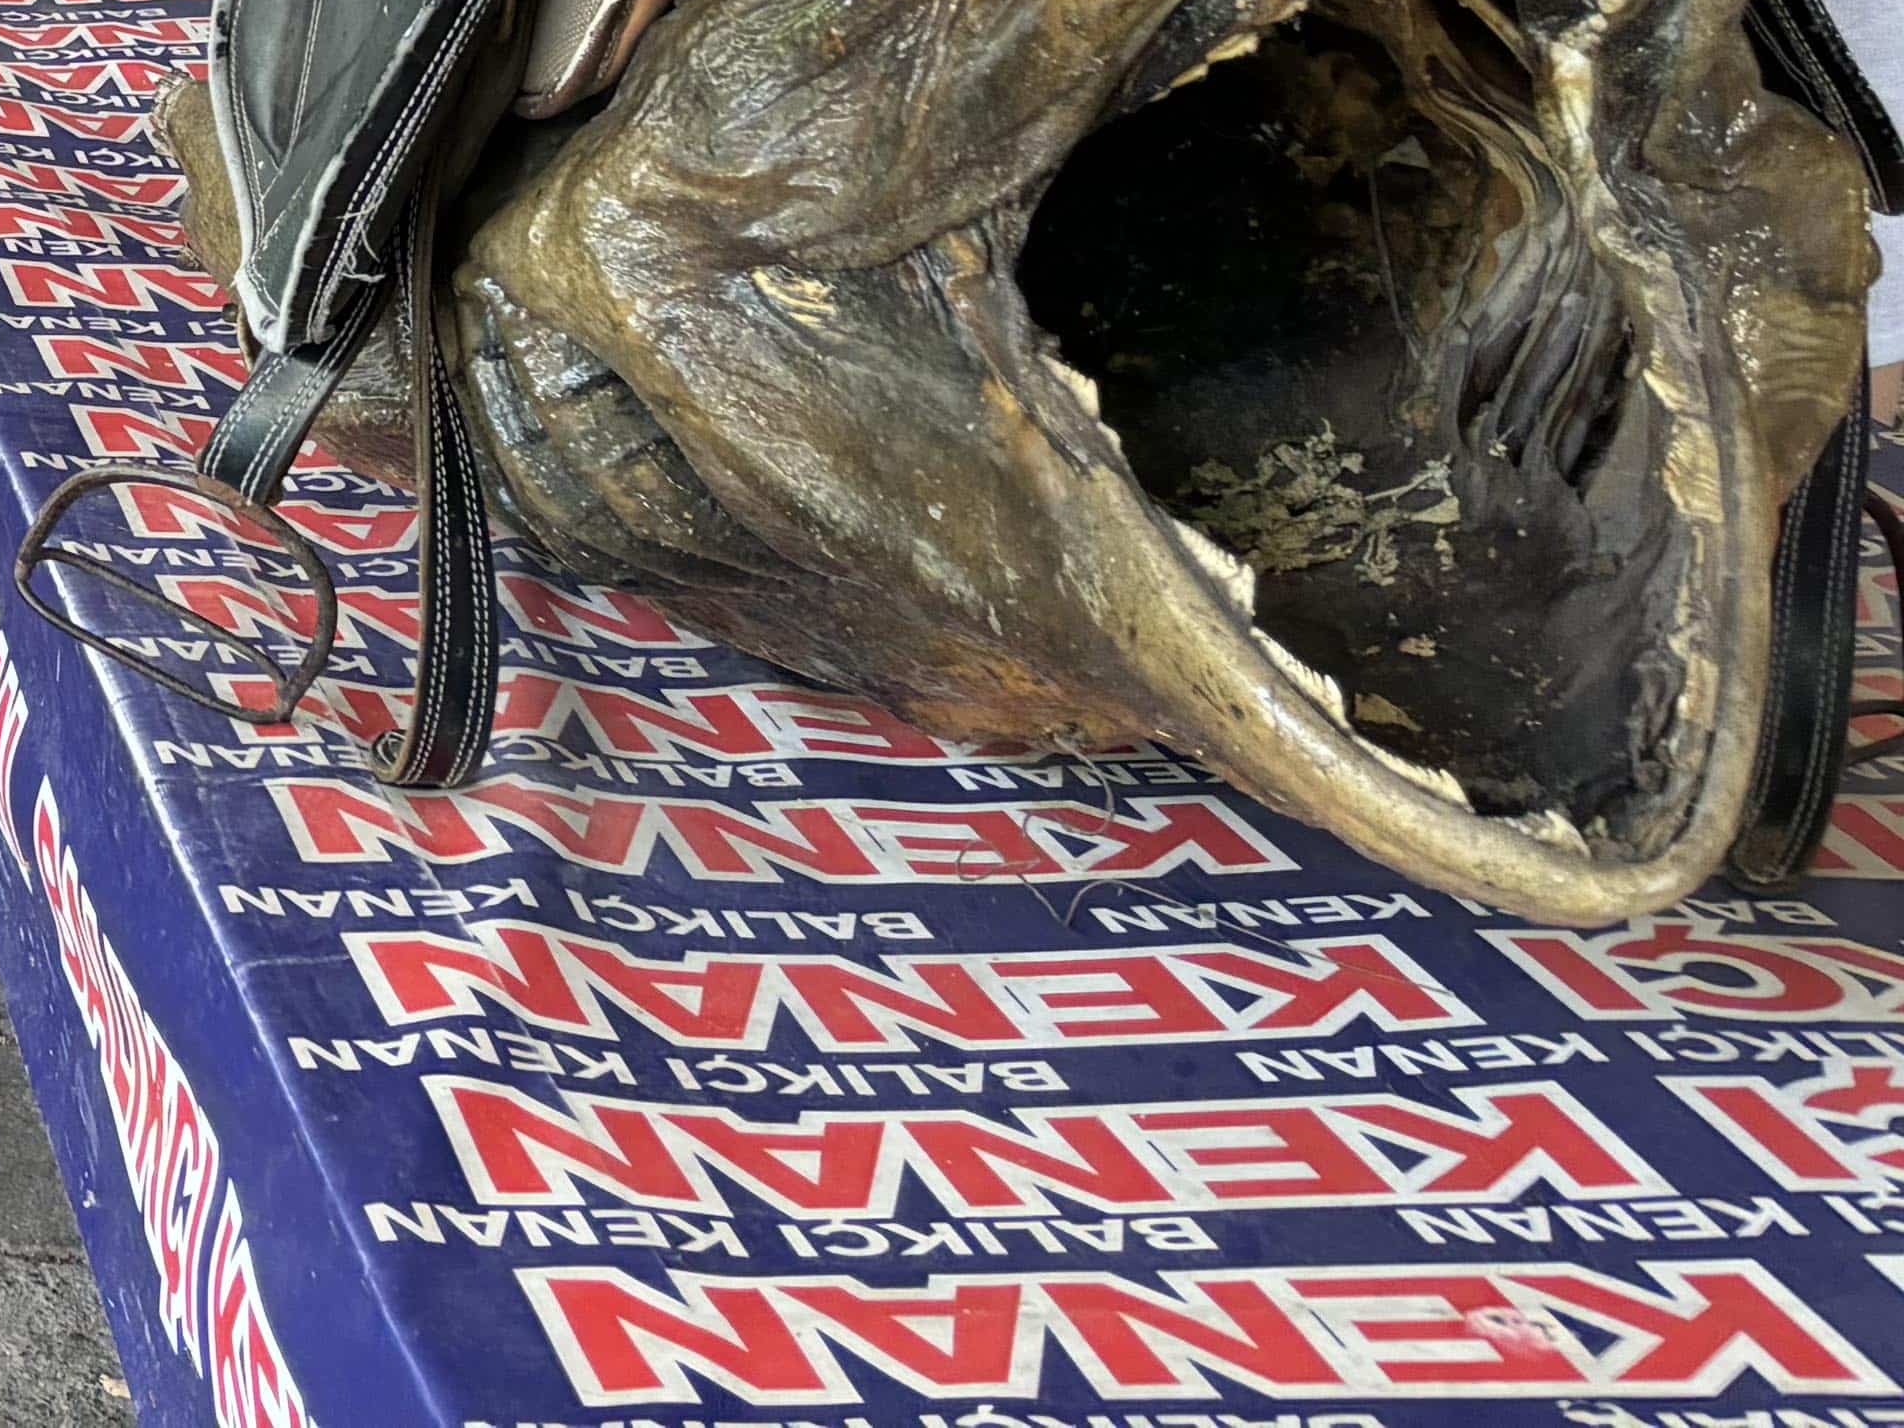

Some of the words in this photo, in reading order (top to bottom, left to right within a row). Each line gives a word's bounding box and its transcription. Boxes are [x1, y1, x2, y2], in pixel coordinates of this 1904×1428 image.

[153, 739, 364, 770] ENAN
[482, 734, 804, 790] BALIKÇ
[261, 774, 1303, 886] KENAN
[220, 881, 540, 921] KENAN
[564, 886, 937, 942] BALIKÇI
[1089, 891, 1432, 934] KENAN
[339, 919, 1486, 1054] KENAN
[288, 1026, 638, 1086] KENAN
[664, 1051, 1073, 1098] BALIKÇI
[1235, 1030, 1608, 1085] KENAN
[419, 1074, 1681, 1222] KENAN
[363, 1200, 751, 1258] KENAN
[779, 1212, 1220, 1261] BALIKÇI
[1394, 1196, 1811, 1244] KENAN
[511, 1258, 1903, 1408] KENAN
